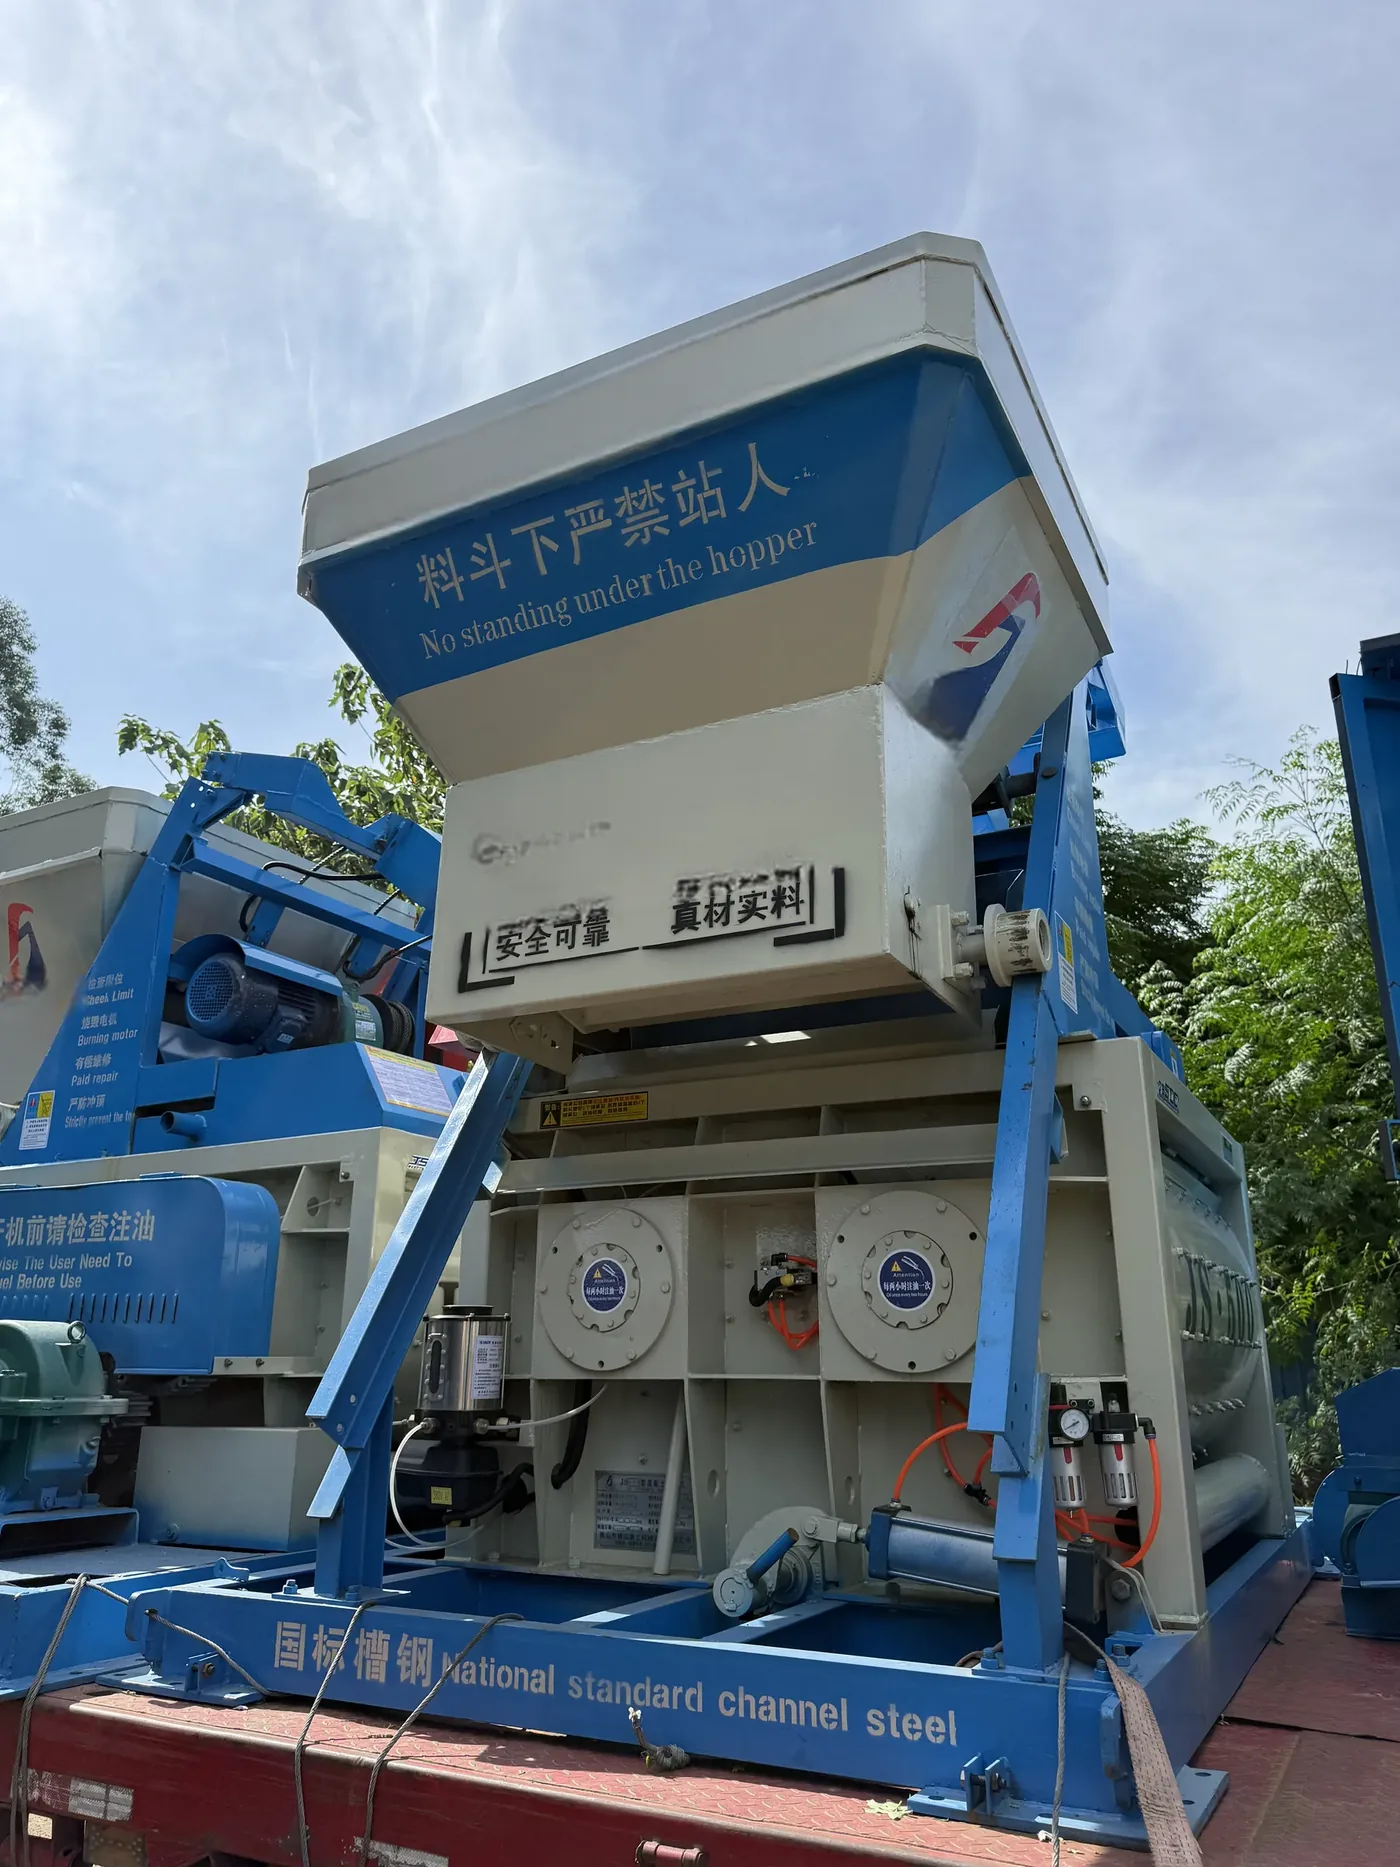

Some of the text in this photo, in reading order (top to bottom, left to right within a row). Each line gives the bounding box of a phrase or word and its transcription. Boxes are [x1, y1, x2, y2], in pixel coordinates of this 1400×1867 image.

[416, 442, 791, 609] 料斗下严禁站人
[419, 518, 818, 659] No standing under the hopper
[496, 881, 805, 962] 安全可靠 真材实料
[112, 987, 135, 1002] Limit
[77, 1028, 139, 1047] Burning motor
[71, 1070, 119, 1087] Paid repair
[0, 1209, 156, 1247] 机前请检查注油
[24, 1255, 45, 1270] The
[49, 1253, 77, 1270] User
[79, 1251, 111, 1270] Need
[116, 1251, 133, 1269] To
[17, 1273, 56, 1289] Before
[60, 1272, 83, 1289] Use
[273, 1620, 434, 1689] 国标槽钢
[442, 1651, 958, 1747] National standard channel steel
